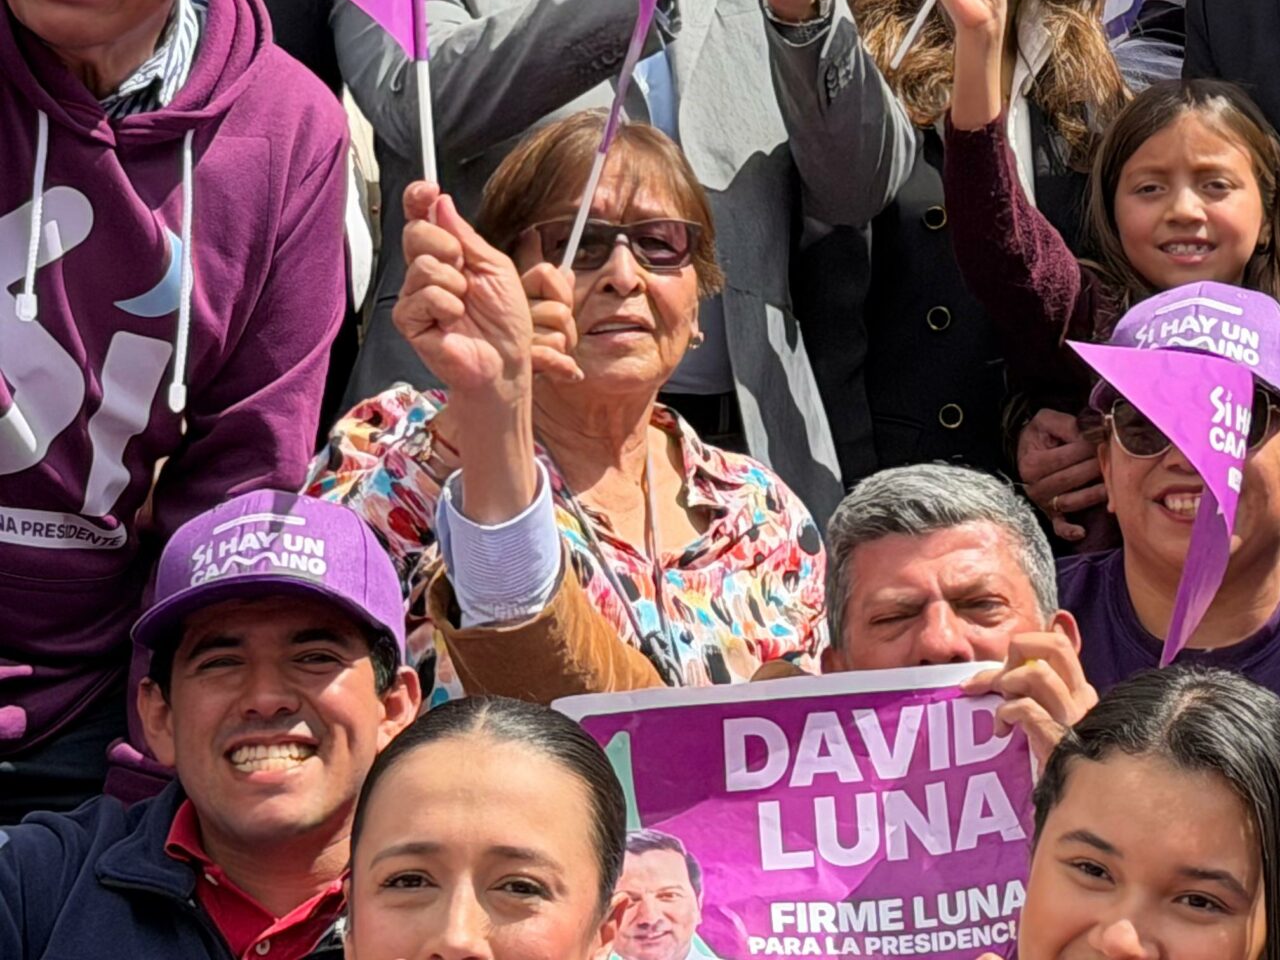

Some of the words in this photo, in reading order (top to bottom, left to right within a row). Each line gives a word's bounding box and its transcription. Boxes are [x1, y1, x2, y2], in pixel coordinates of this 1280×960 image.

[1160, 314, 1218, 339] HAY
[1221, 322, 1260, 349] UN
[218, 531, 278, 558] HAY
[282, 533, 325, 557] UN
[723, 694, 1014, 792] DAVID
[758, 771, 1028, 871] LUNA
[770, 898, 905, 935] FIRME
[913, 879, 1027, 930] LUNA
[748, 936, 816, 956] PARA
[824, 935, 861, 955] LA
